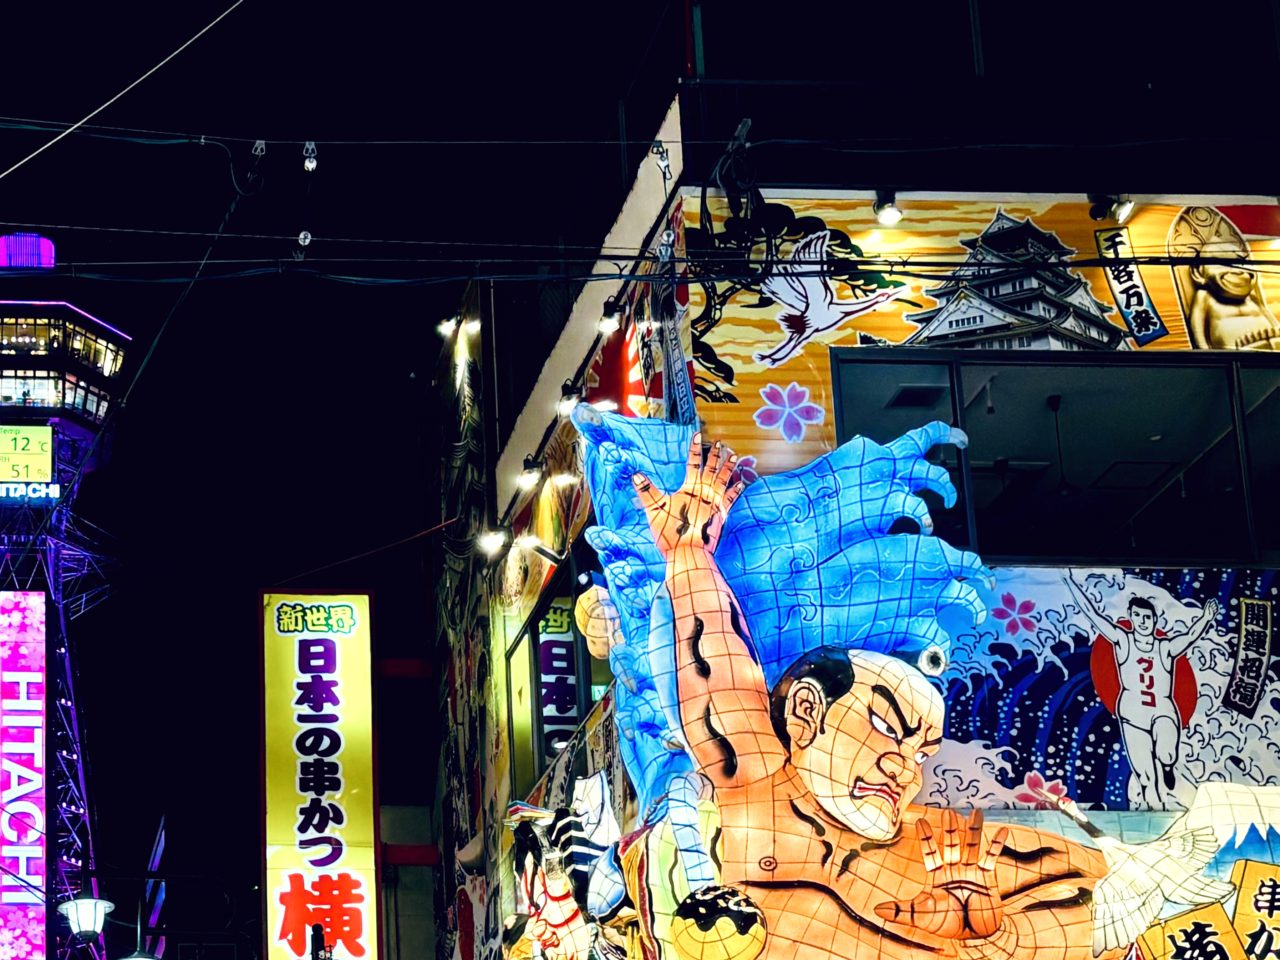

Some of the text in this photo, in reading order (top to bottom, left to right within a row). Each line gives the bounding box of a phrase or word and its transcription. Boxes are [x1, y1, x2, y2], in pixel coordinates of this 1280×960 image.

[10, 437, 31, 452] 12
[11, 464, 30, 479] 51
[278, 603, 356, 633] 新世界
[1136, 656, 1156, 708] グリコ
[295, 638, 344, 865] 日本一の串かつ
[0, 670, 45, 904] HITACHI
